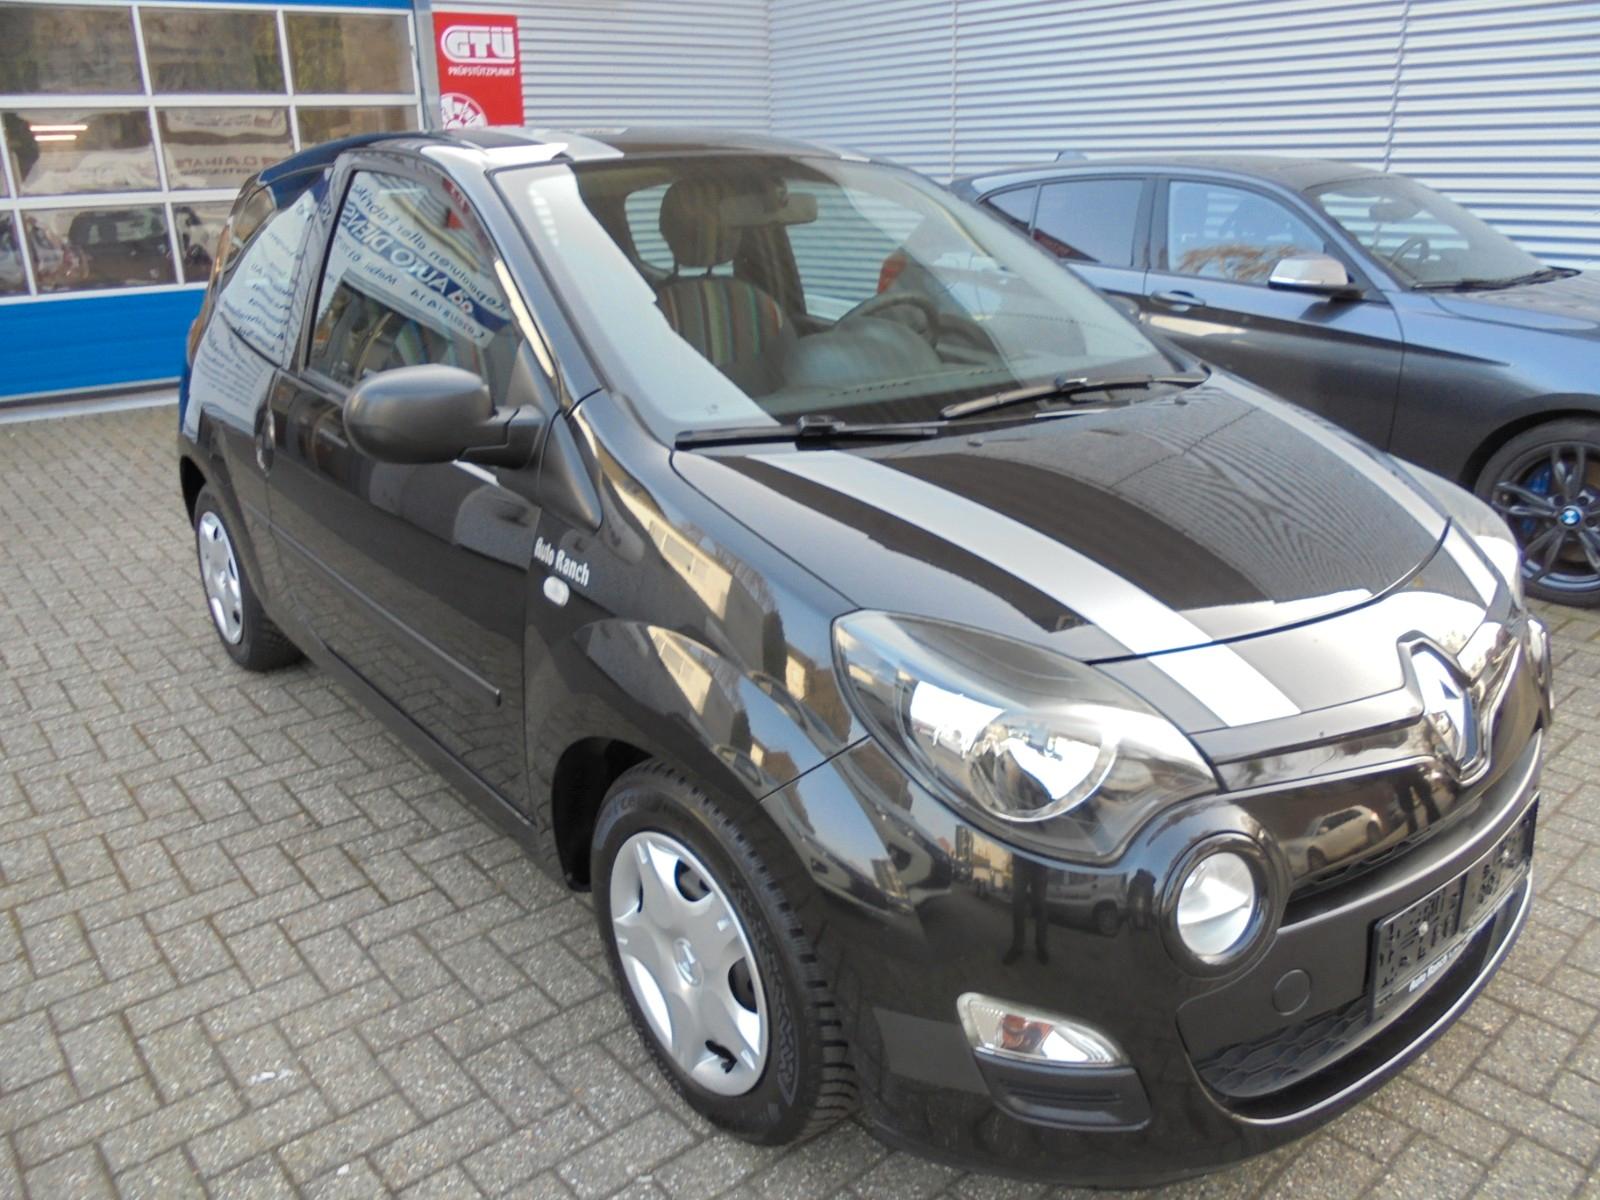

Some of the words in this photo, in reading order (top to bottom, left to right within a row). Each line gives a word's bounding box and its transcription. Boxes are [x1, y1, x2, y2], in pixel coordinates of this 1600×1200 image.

[442, 25, 516, 62] GTÜ
[534, 536, 555, 566] Auto
[555, 549, 590, 587] Ranch
